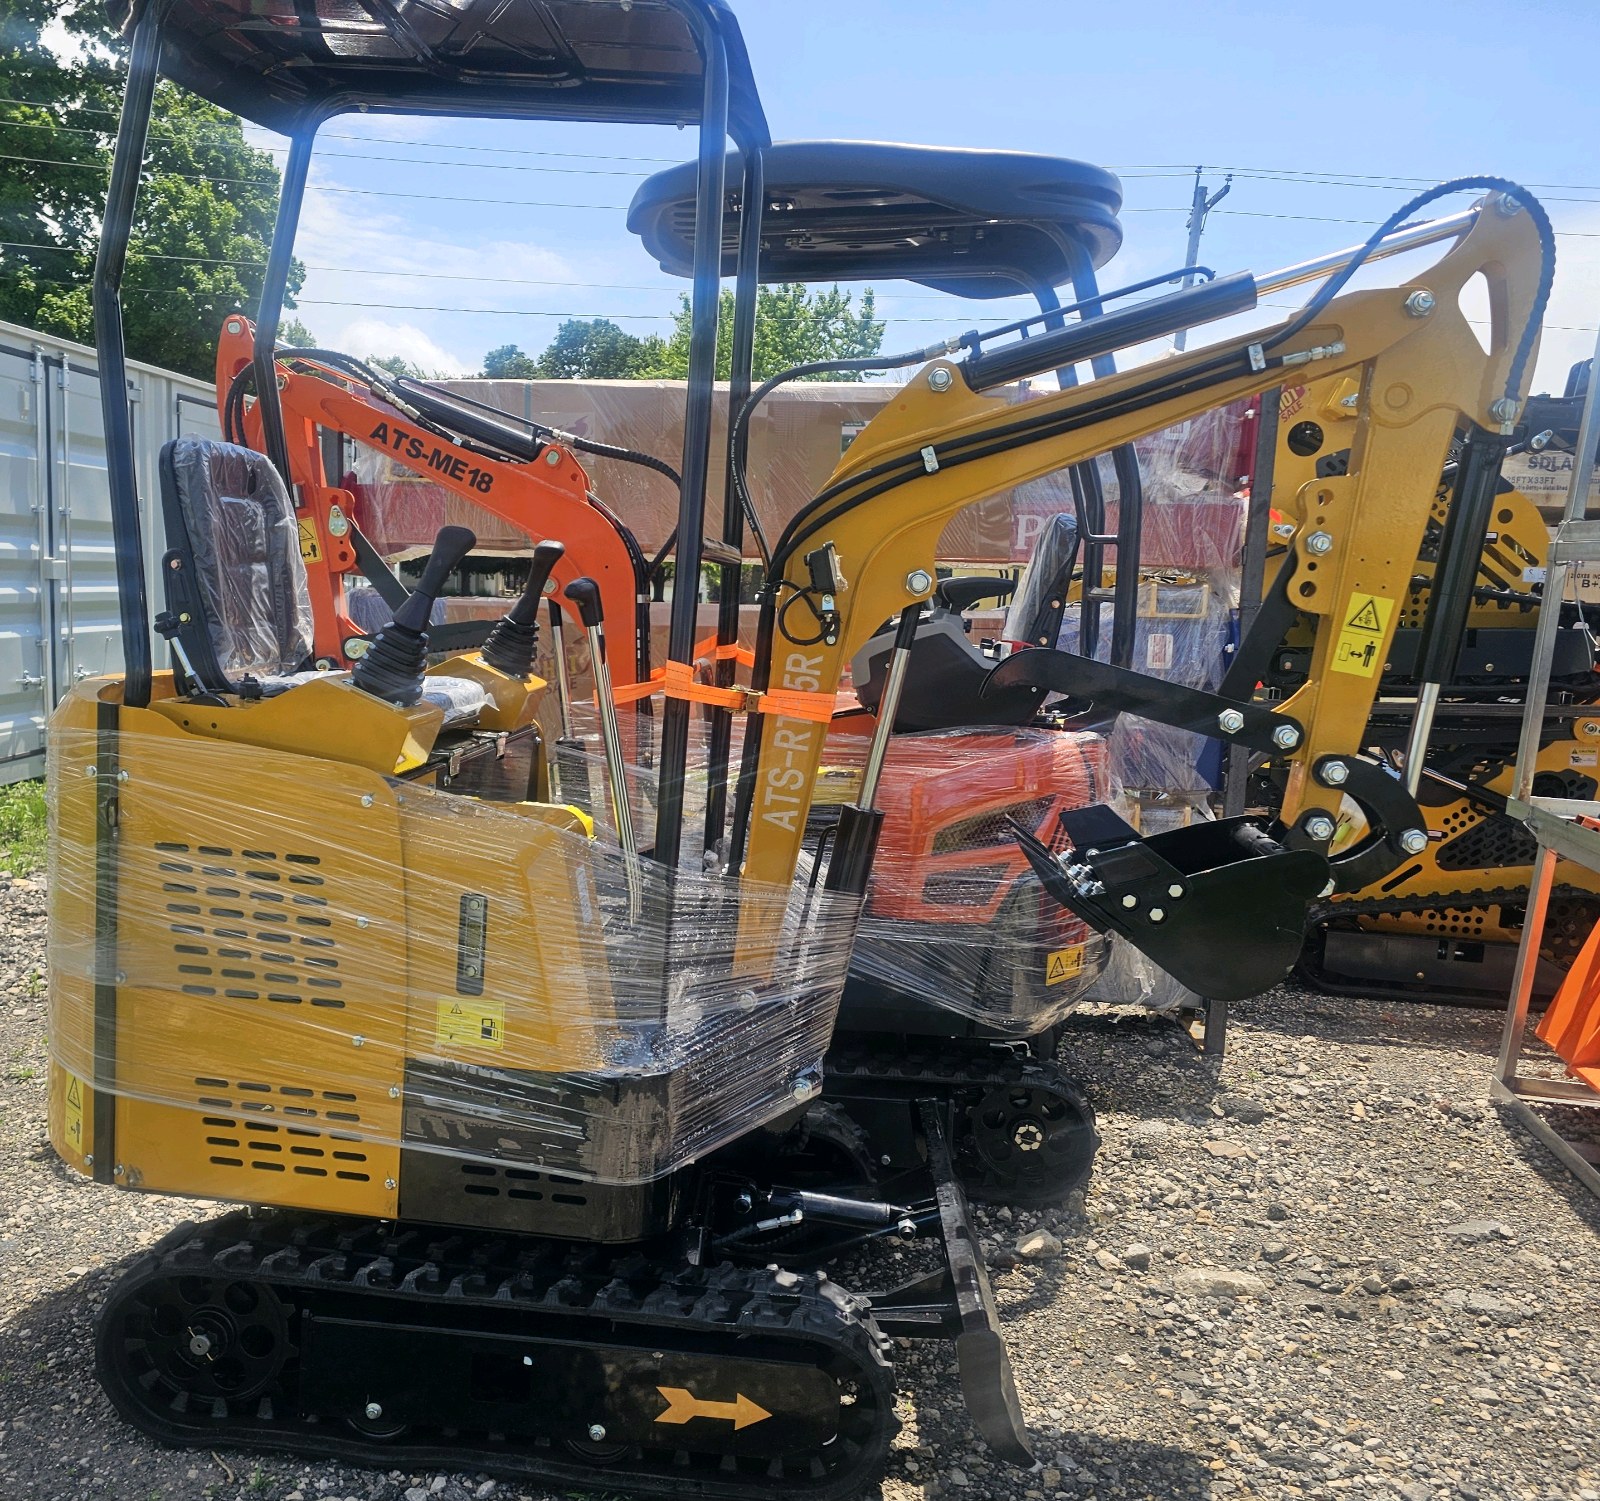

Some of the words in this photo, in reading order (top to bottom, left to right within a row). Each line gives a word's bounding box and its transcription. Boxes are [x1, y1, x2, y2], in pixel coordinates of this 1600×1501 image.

[1281, 400, 1304, 423] SALE
[369, 421, 494, 494] ATS-ME18
[762, 652, 824, 833] ATS-RT5R
